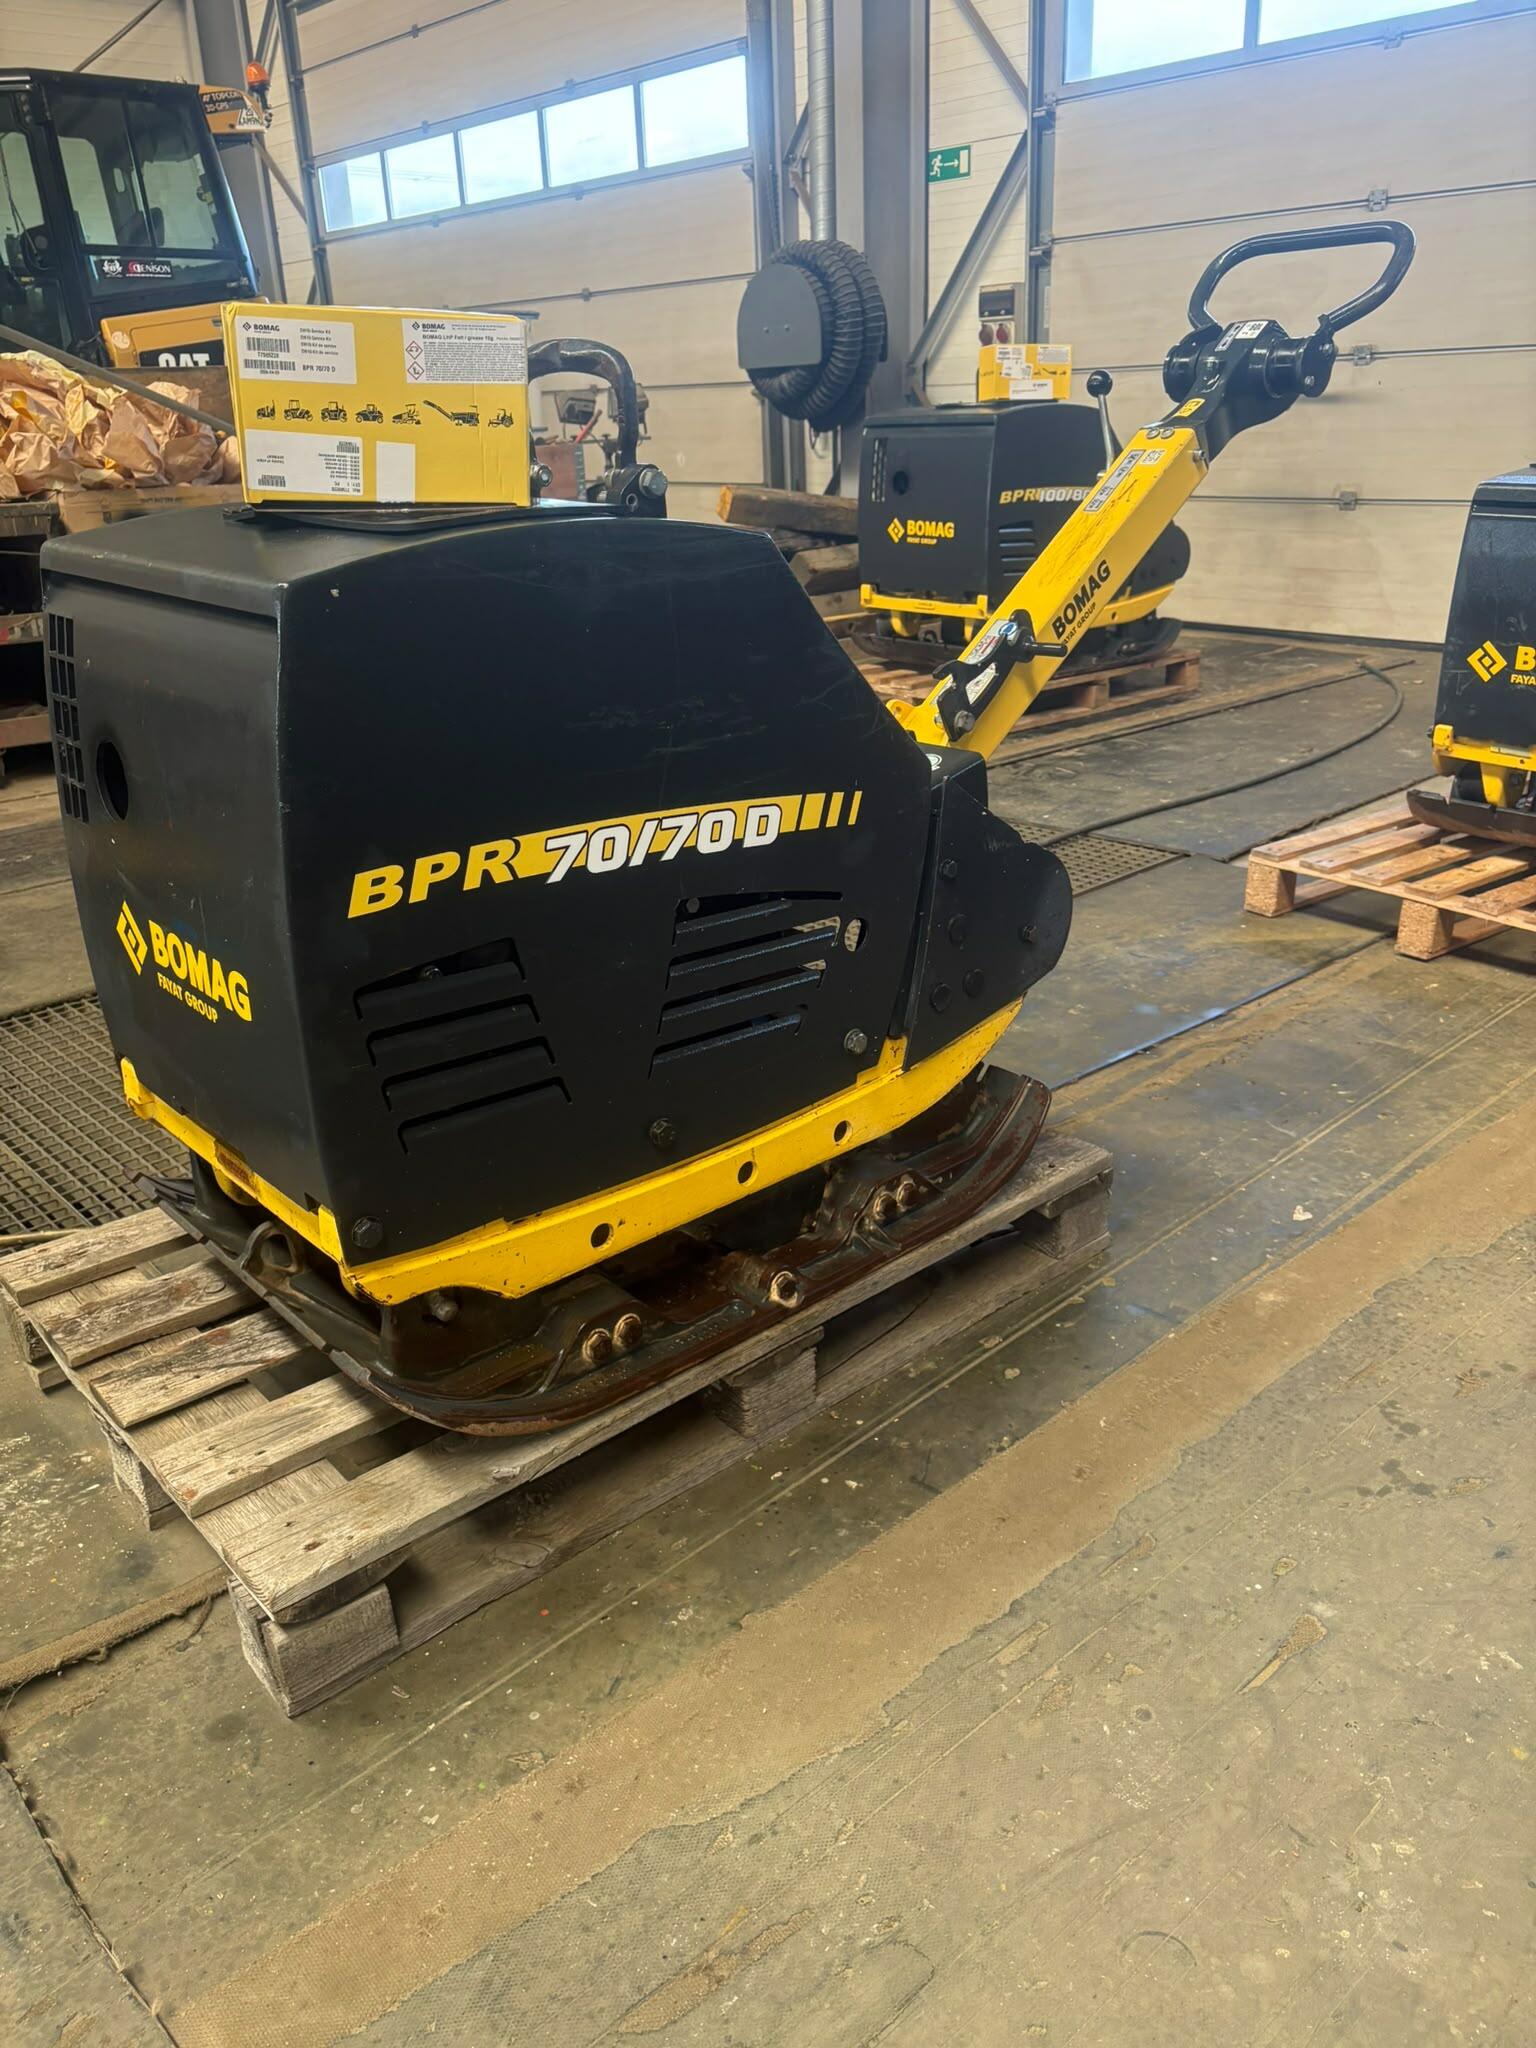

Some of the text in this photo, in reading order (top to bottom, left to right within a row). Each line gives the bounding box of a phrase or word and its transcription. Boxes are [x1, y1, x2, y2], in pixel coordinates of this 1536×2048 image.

[253, 323, 280, 332] BOMAG
[999, 488, 1036, 504] BPR
[907, 519, 955, 538] BOMAG
[1052, 559, 1111, 640] BOMAG
[1077, 602, 1096, 629] GROUP
[347, 804, 782, 918] BPR 70/70 D
[148, 919, 253, 1021] BOMAG
[157, 971, 219, 1023] FAYAT GROUP
